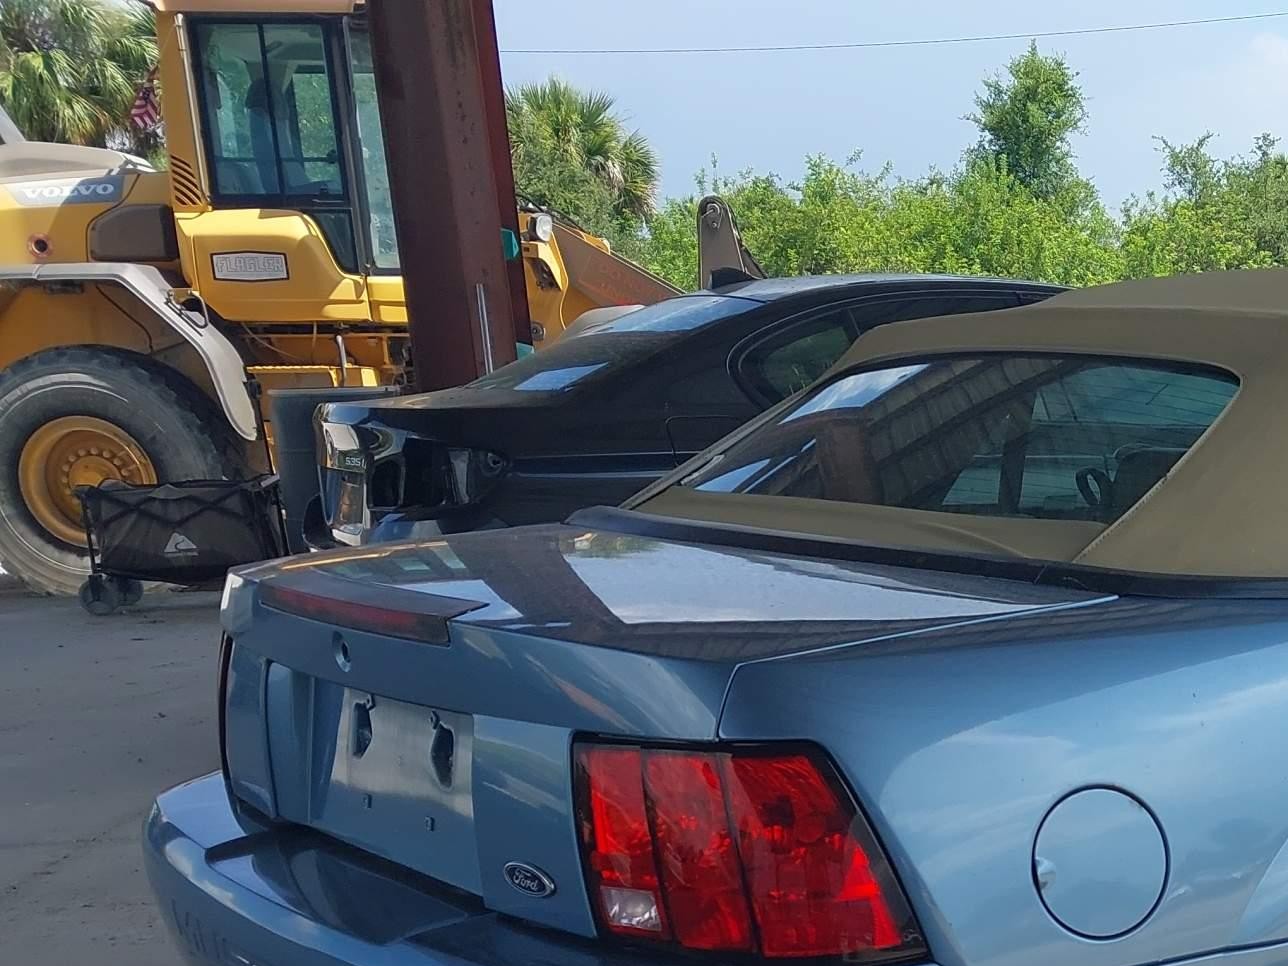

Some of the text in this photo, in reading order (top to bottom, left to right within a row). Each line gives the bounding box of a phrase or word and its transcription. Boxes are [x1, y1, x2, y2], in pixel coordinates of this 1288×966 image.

[22, 183, 114, 199] VOLVO
[215, 256, 284, 273] FLAGLER
[512, 868, 539, 892] Ford
